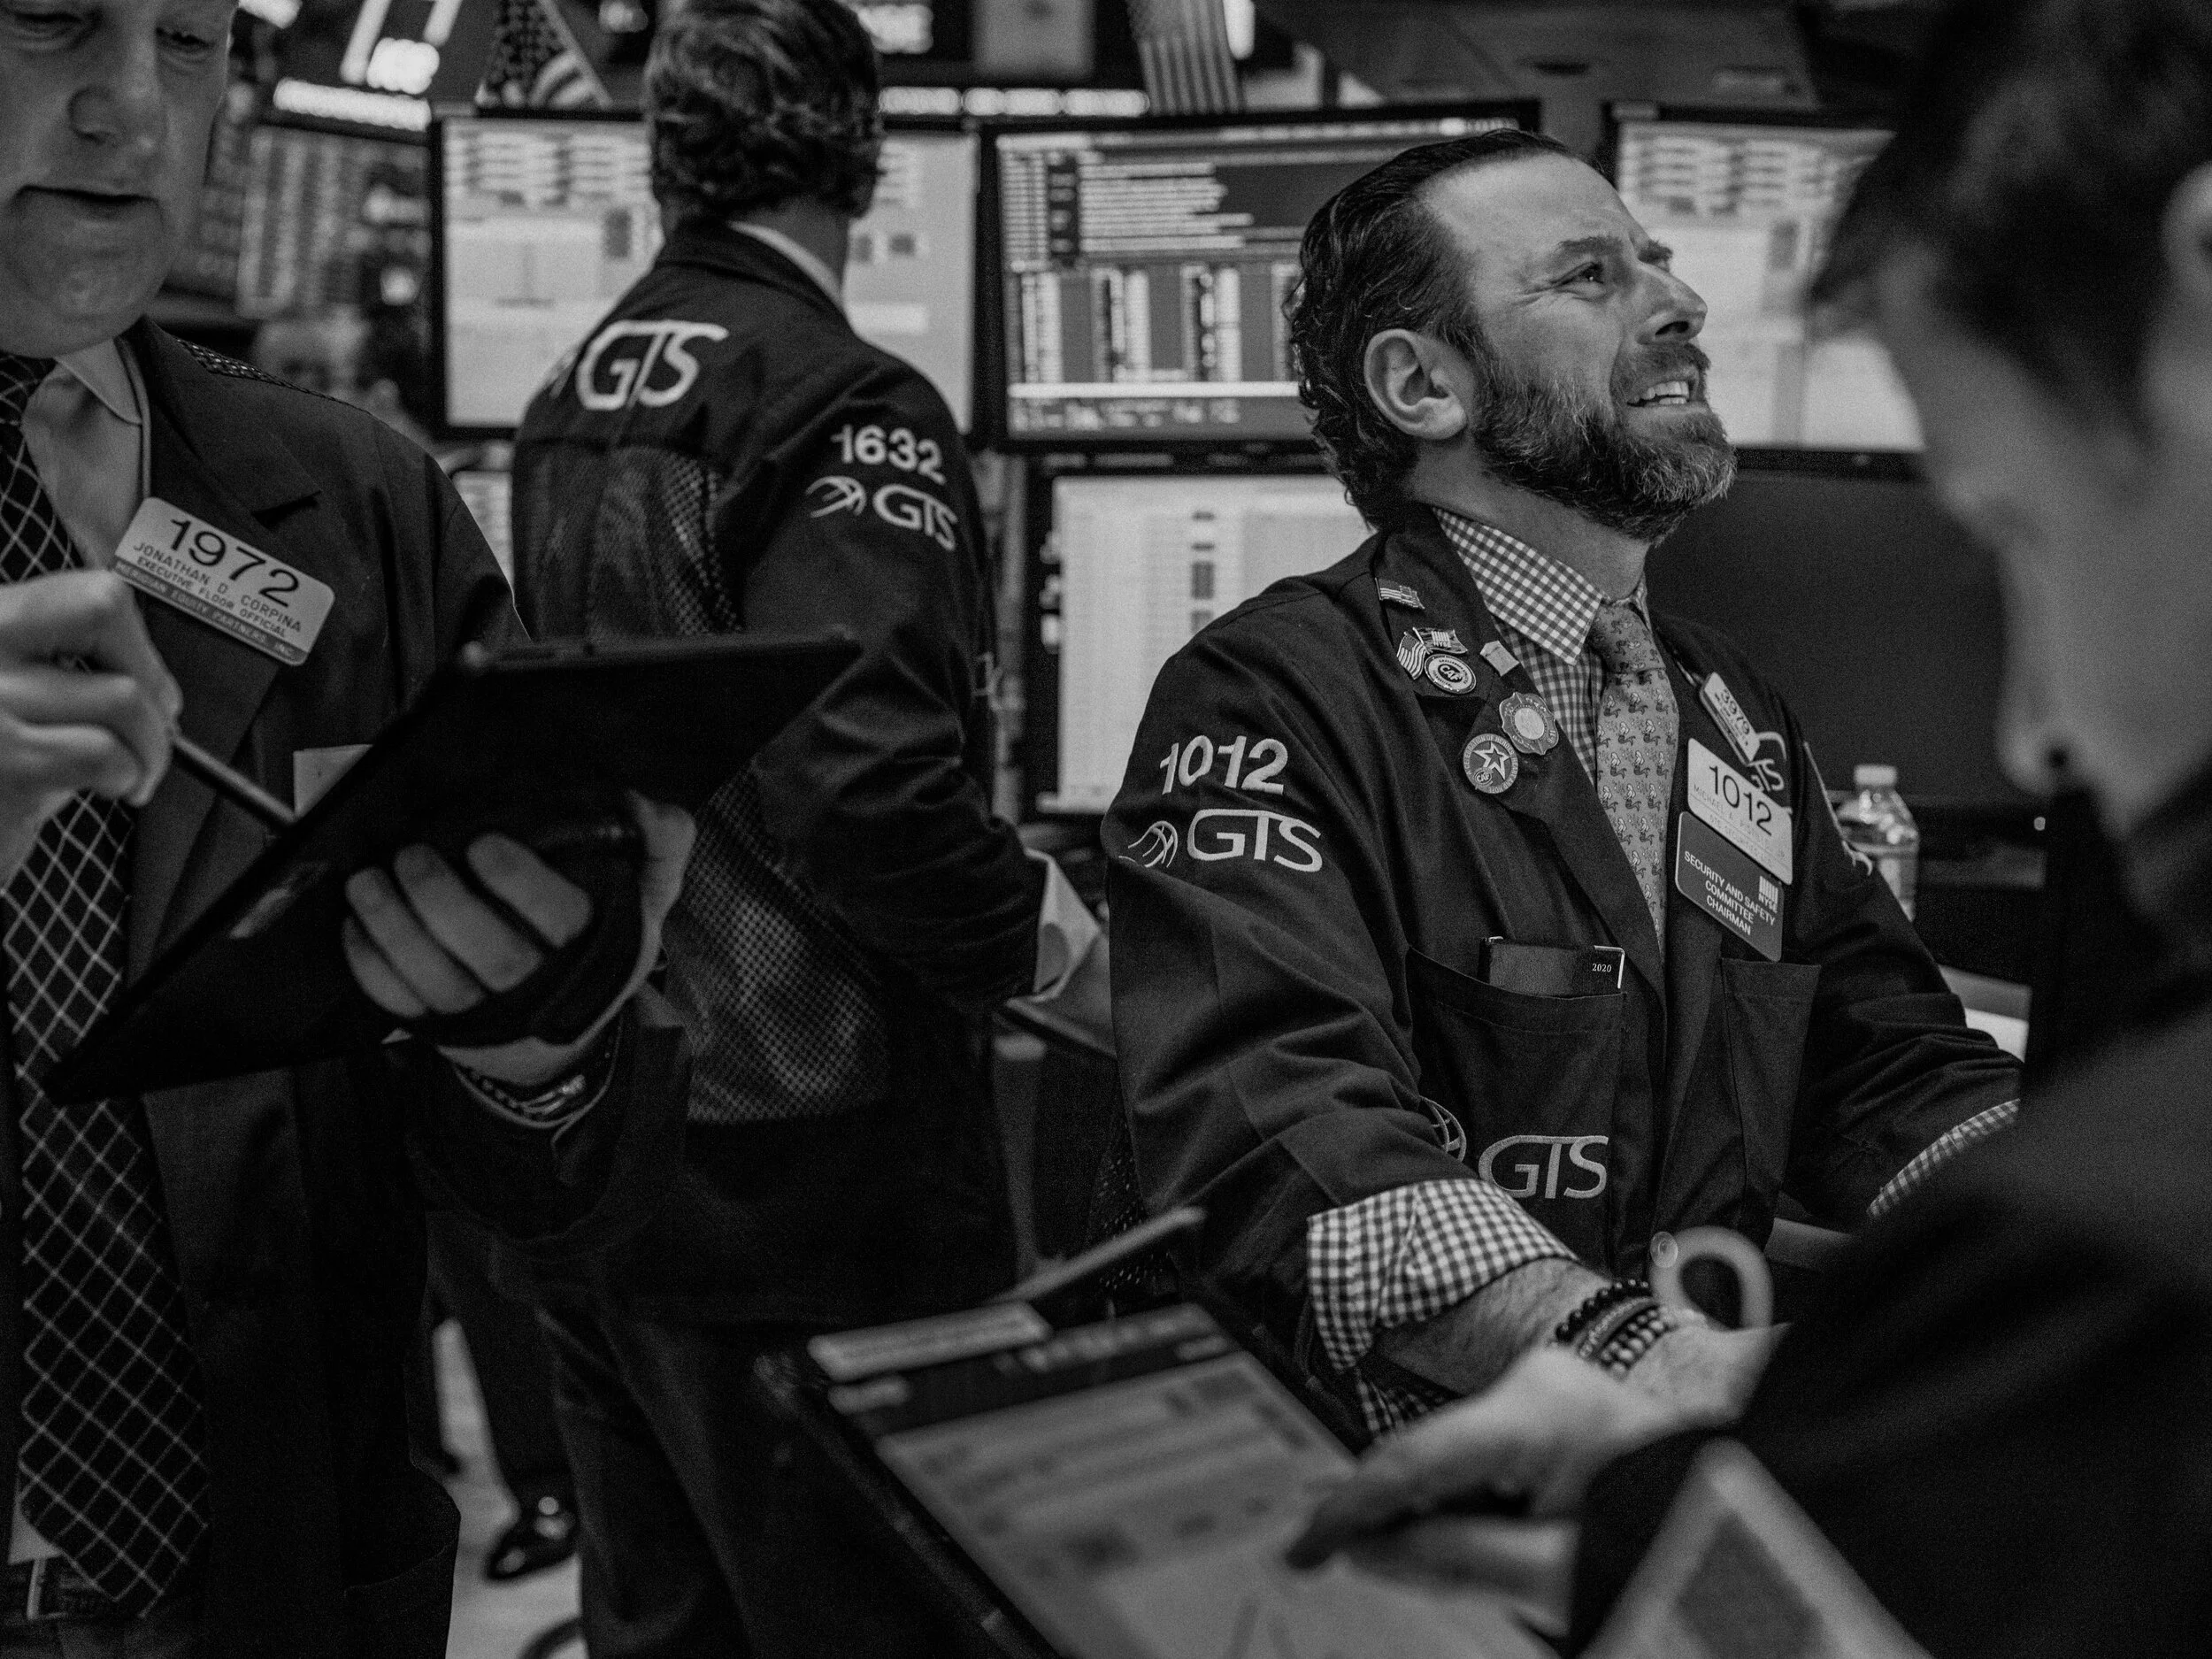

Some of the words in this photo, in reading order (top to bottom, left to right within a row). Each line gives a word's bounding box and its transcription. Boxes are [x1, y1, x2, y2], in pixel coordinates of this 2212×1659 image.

[575, 319, 729, 411] GTS
[830, 424, 946, 485] 1632
[872, 483, 958, 551] GTS
[134, 542, 211, 585] JONATHAN
[241, 595, 301, 633] CORPINA
[171, 518, 299, 608] 1972
[137, 557, 192, 588] EXECUTIVE
[198, 587, 234, 611] FLOOR
[240, 608, 286, 637] OFFICIAL
[1160, 735, 1287, 795] 1012
[1709, 765, 1772, 836] 1012
[1187, 809, 1323, 872] GTS
[1685, 850, 1724, 887] SECURITY
[1725, 883, 1744, 902] AND
[1744, 896, 1775, 926] SAFETY
[1705, 879, 1754, 924] COMMITTEE
[1707, 895, 1751, 935] CHAIRMAN
[1593, 964, 1612, 972] 2020
[1478, 1134, 1609, 1199] GTS
